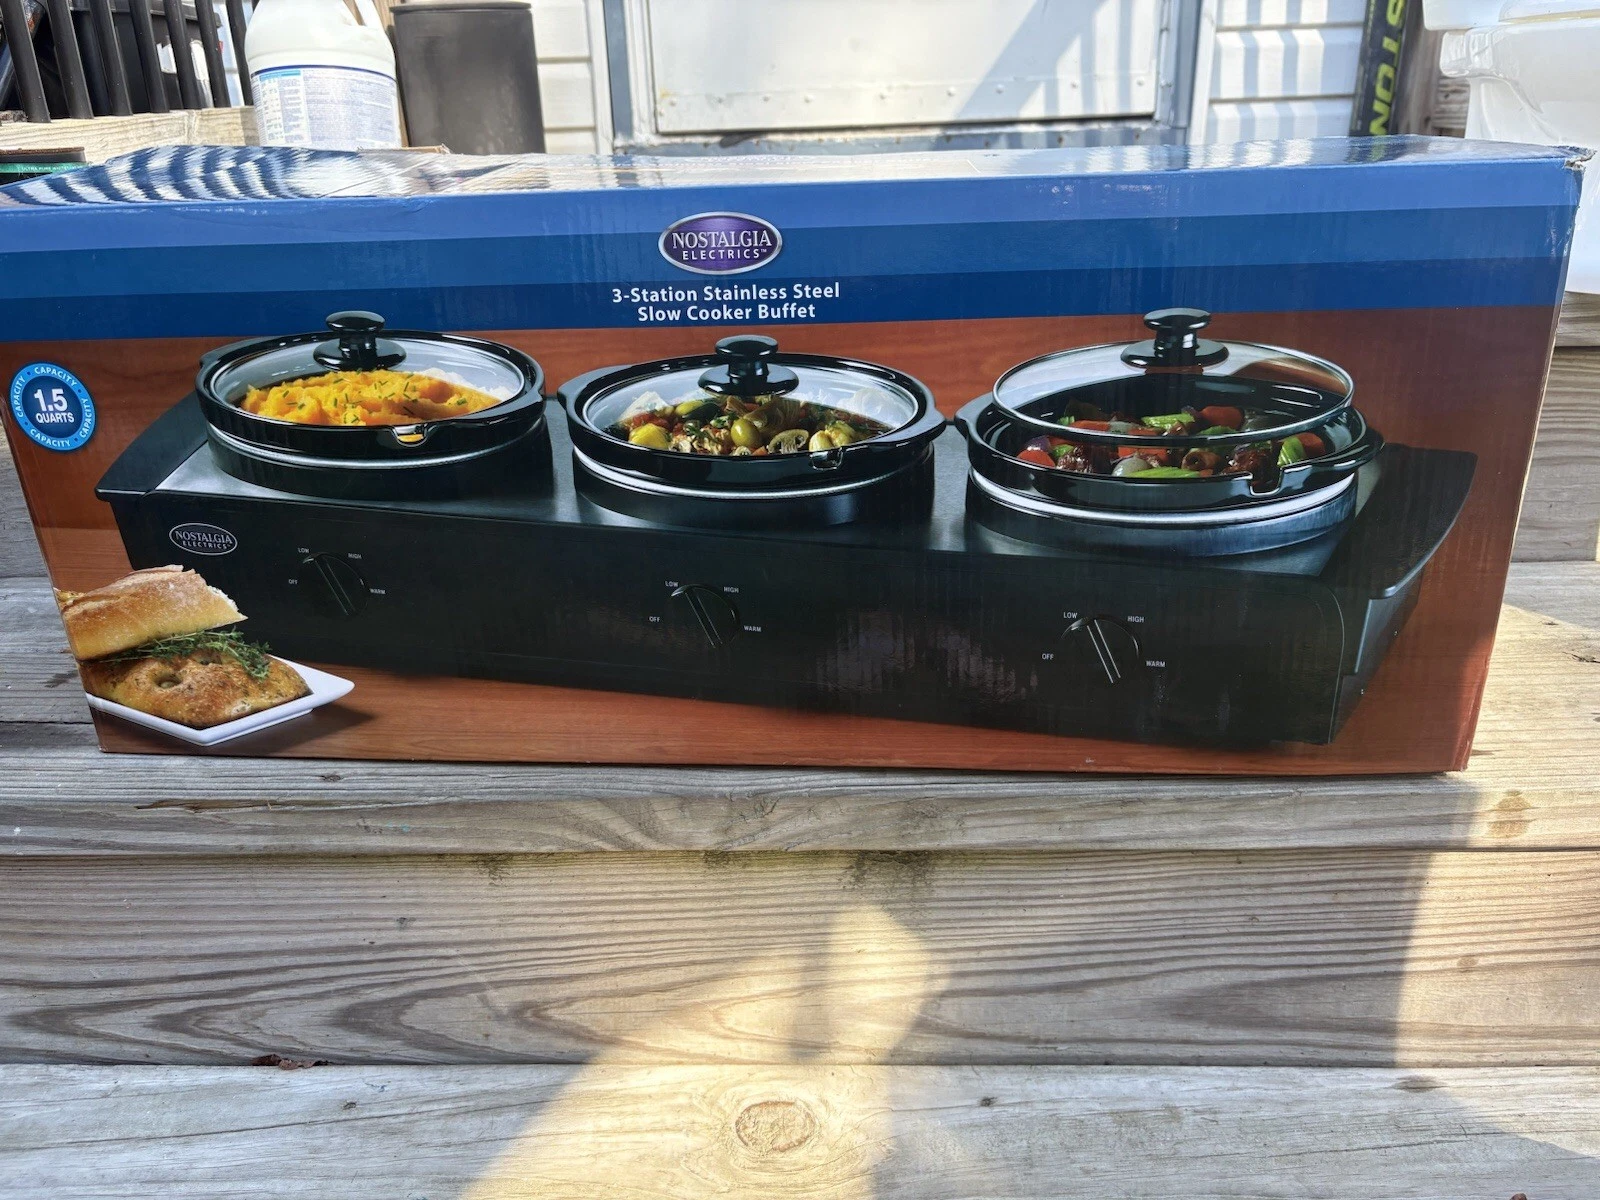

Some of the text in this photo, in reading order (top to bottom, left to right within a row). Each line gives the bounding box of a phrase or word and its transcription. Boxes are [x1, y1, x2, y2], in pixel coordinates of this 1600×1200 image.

[672, 230, 772, 249] NOSTALGIA
[612, 281, 840, 303] 3-Station Stainless Steel
[637, 302, 816, 322] Slow Cooker Buffet
[34, 366, 77, 387] CAPACITY
[13, 375, 26, 418] CAPACITY
[33, 388, 68, 412] 1.5
[35, 412, 75, 424] QUARTS
[79, 397, 92, 438] CAPACITY
[30, 428, 71, 447] CAPACITY
[174, 530, 233, 544] NOSTALGIA
[1127, 615, 1145, 623] HIGH
